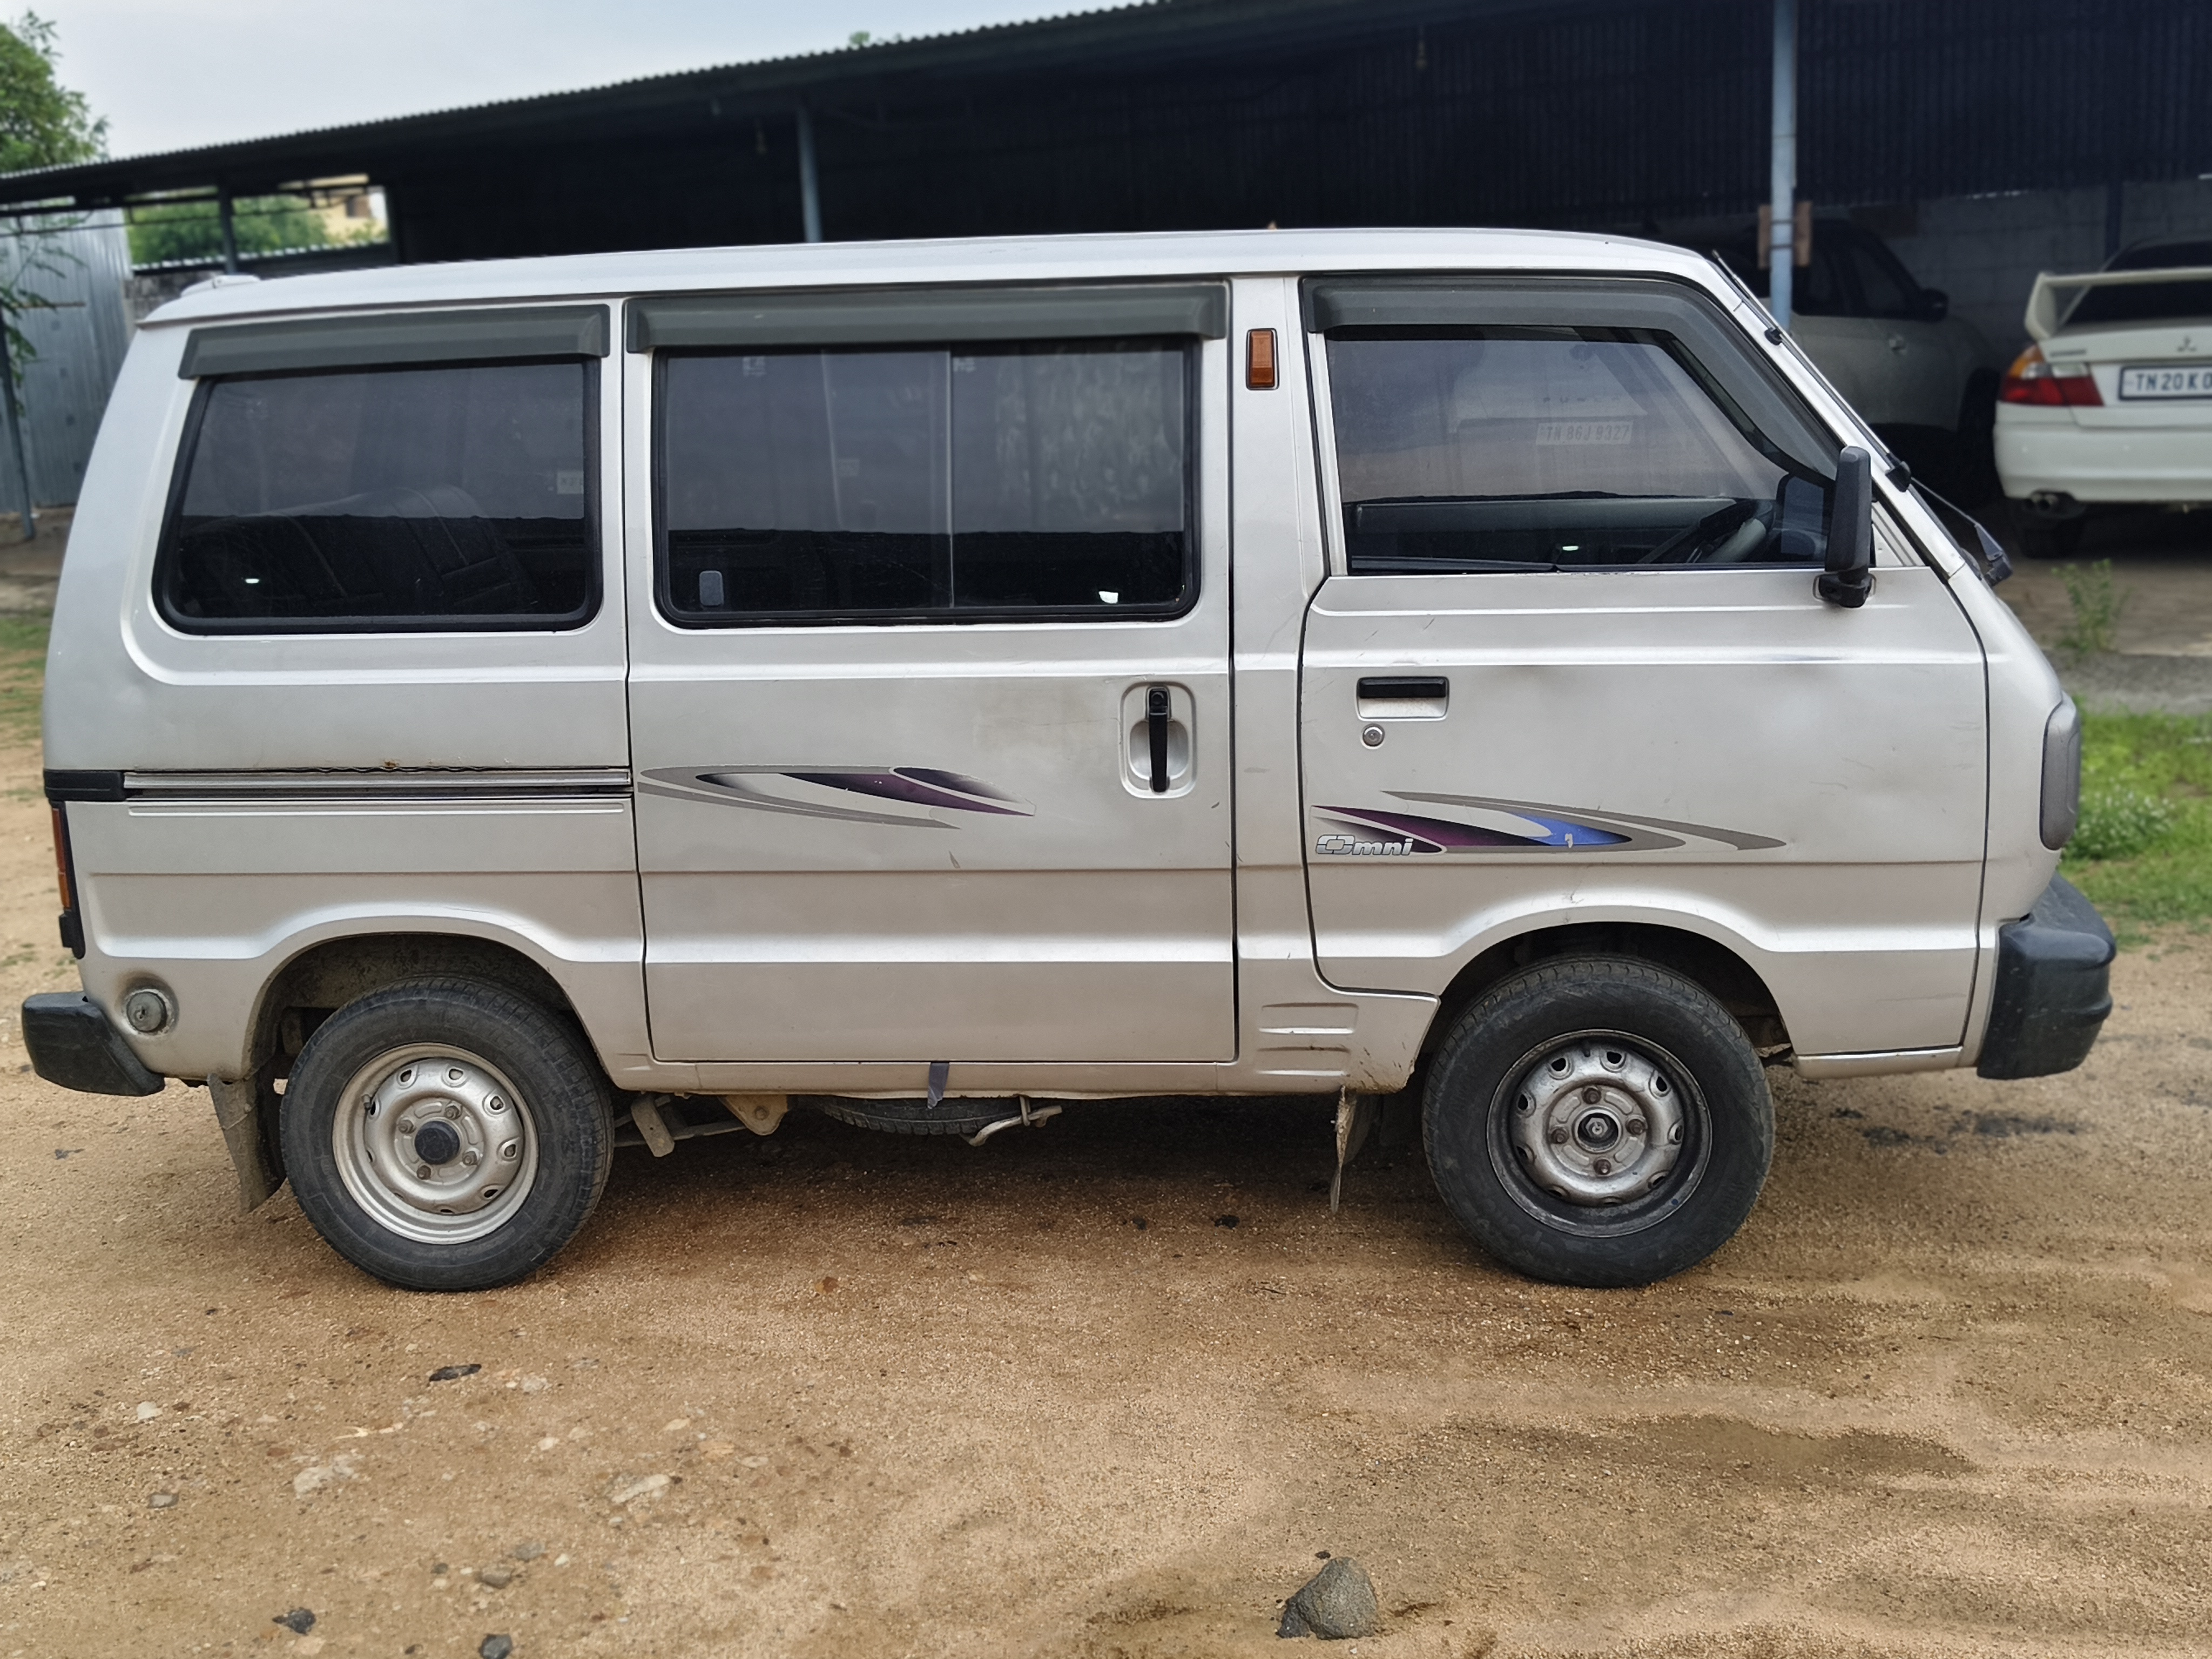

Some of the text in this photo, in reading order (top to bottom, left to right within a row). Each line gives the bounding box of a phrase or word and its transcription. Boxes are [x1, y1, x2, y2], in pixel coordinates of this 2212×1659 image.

[2136, 373, 2157, 391] TN
[2161, 373, 2183, 391] 20
[2187, 373, 2198, 390] K
[1316, 834, 1413, 855] Omni
